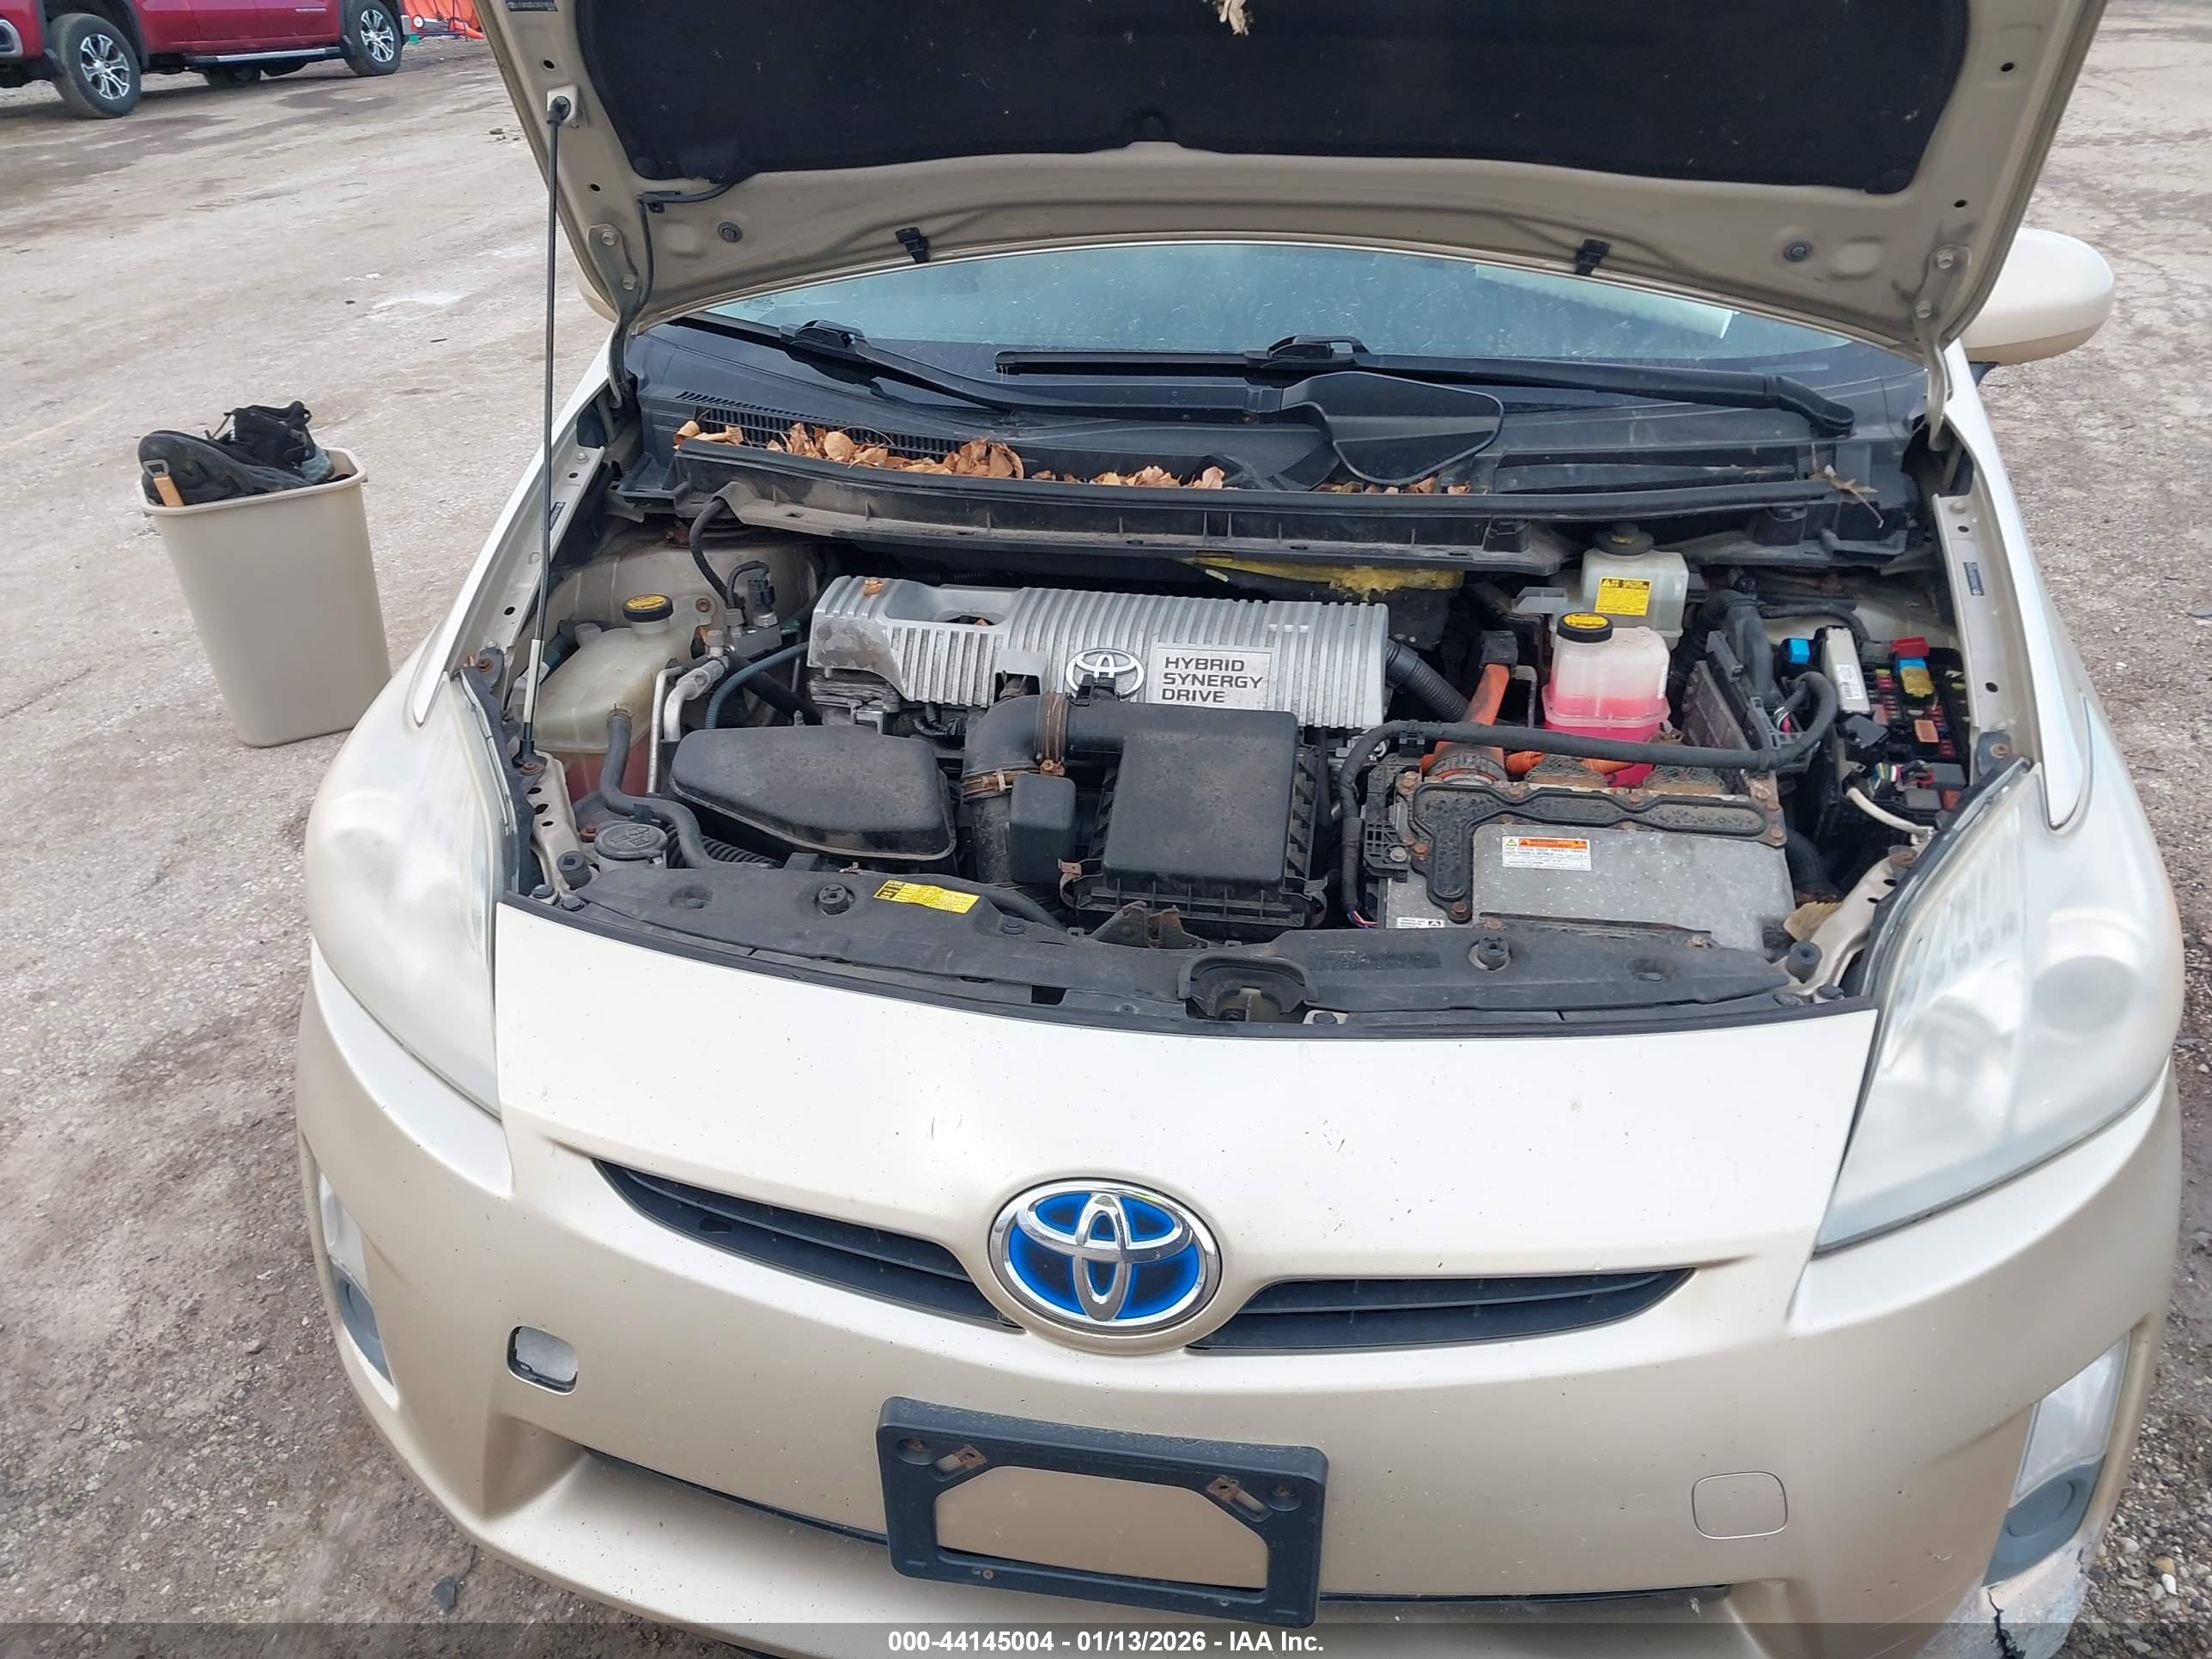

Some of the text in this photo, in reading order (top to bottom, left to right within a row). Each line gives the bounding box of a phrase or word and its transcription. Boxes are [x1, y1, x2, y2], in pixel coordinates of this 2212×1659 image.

[1164, 657, 1245, 672] HYBRID
[1163, 672, 1263, 689] SYNERGY
[1161, 688, 1225, 703] DRIVE
